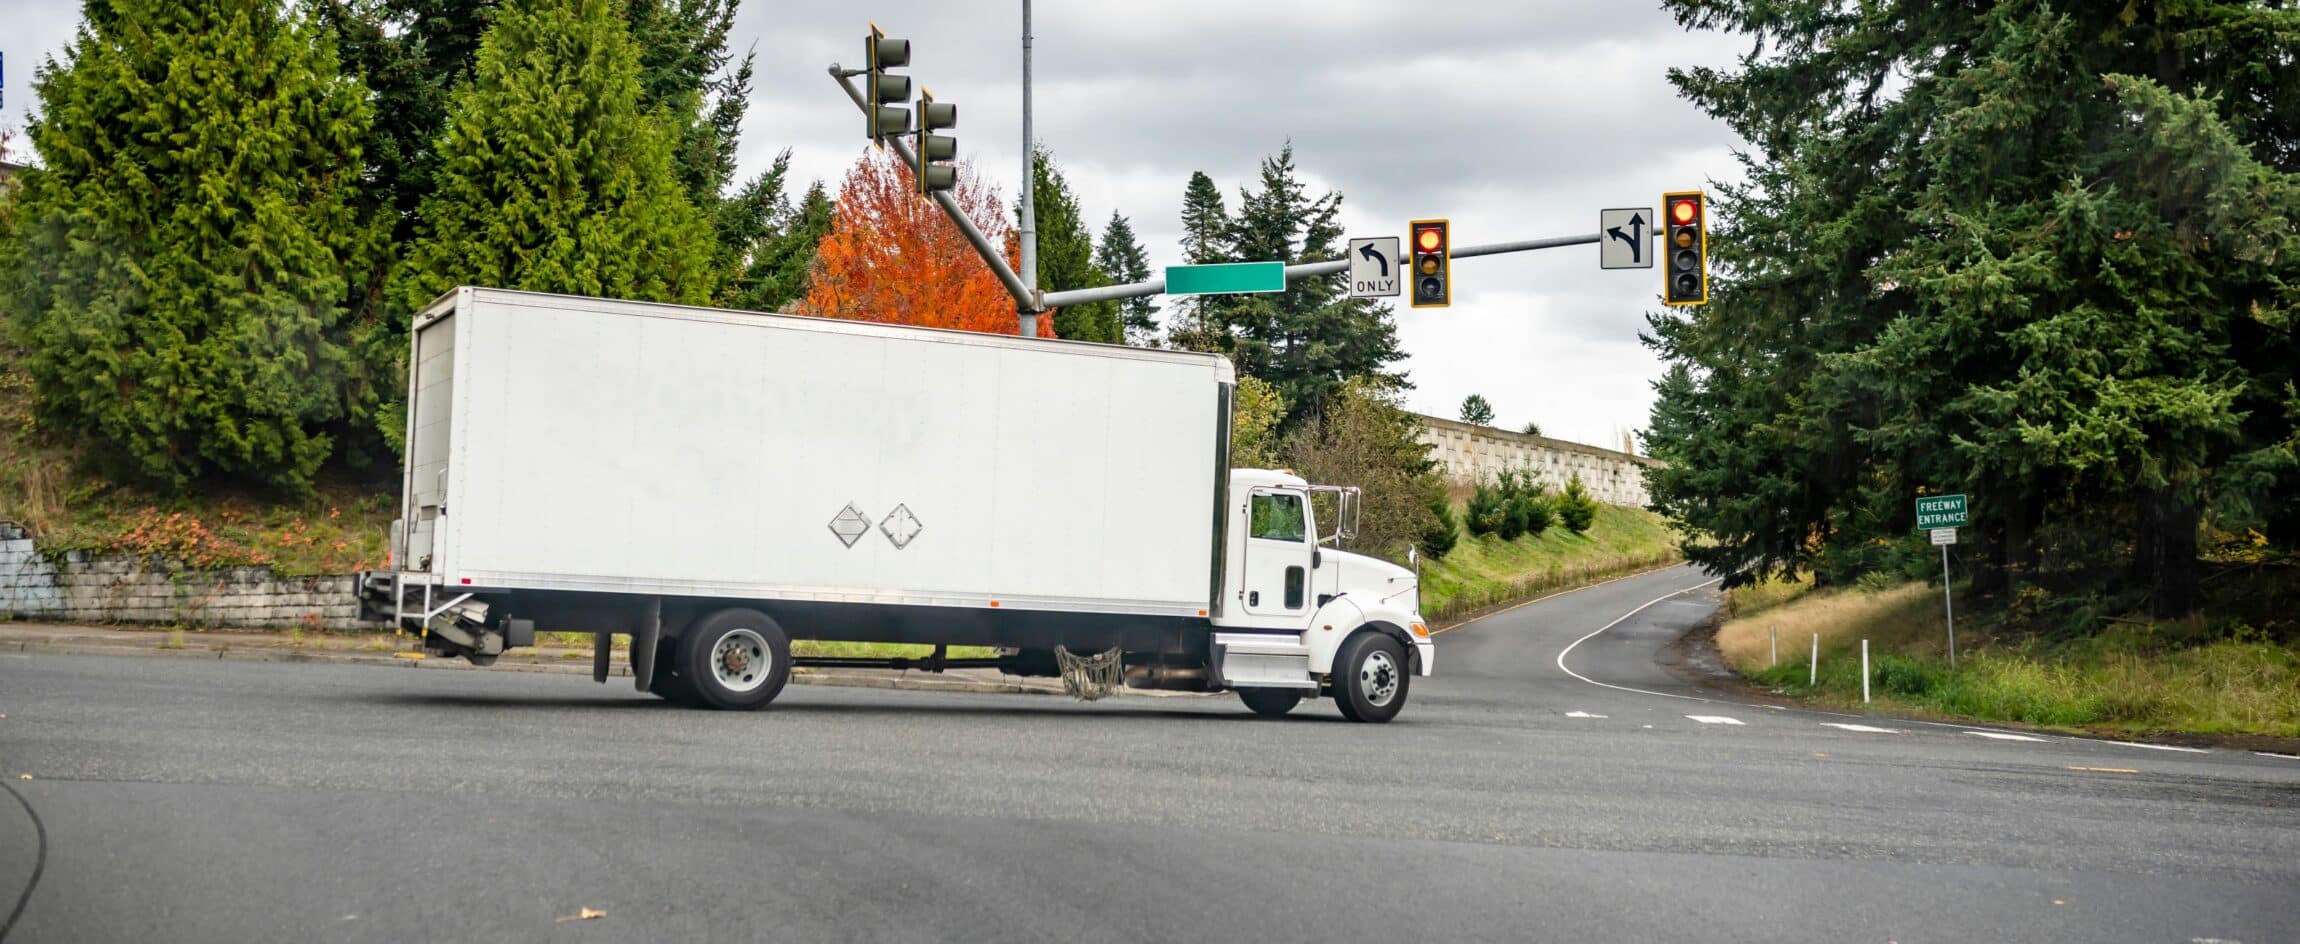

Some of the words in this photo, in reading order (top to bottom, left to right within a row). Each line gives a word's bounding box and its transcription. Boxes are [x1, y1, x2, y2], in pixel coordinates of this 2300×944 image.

[1357, 280, 1394, 293] ONLY
[1920, 499, 1962, 512] FREEWAY
[1919, 512, 1966, 525] ENTRANCE
